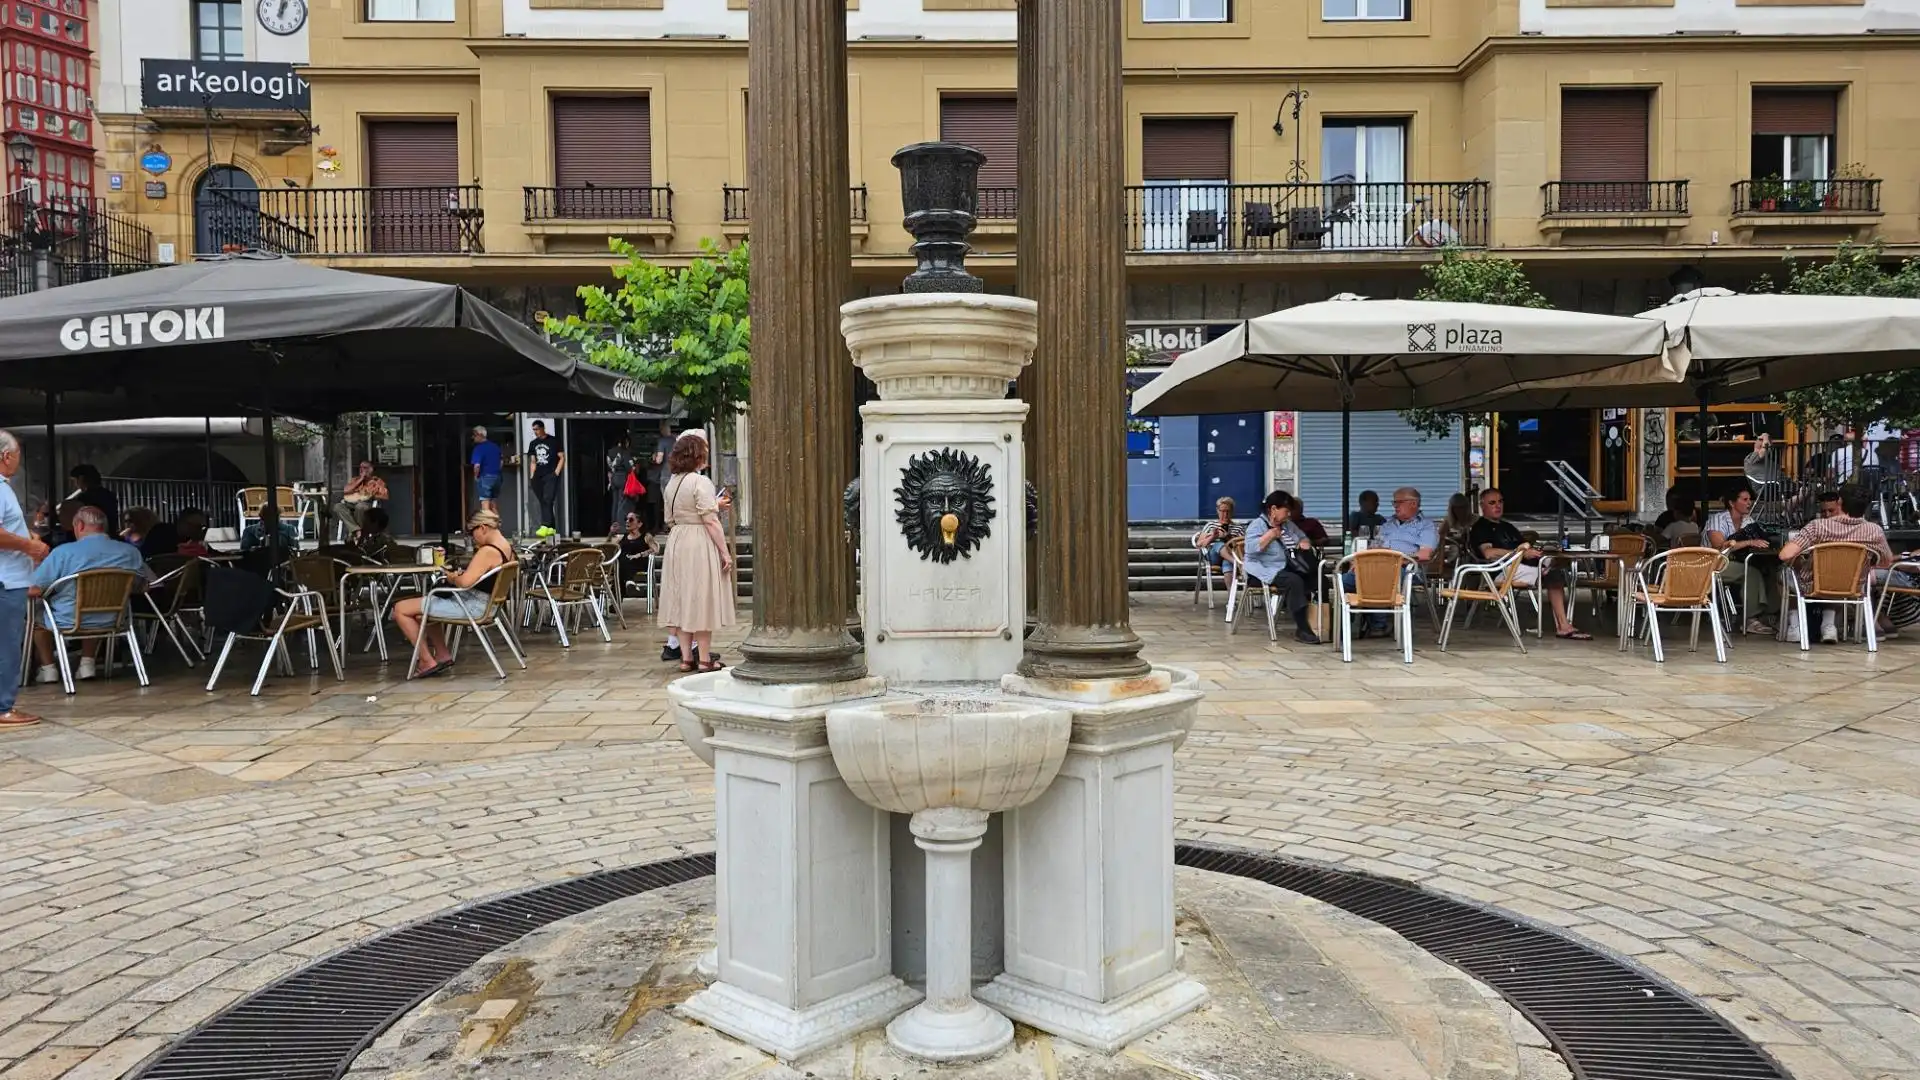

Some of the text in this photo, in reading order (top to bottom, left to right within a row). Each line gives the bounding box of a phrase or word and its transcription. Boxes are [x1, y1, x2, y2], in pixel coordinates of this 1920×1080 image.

[60, 306, 225, 351] GELTOKI
[1446, 322, 1503, 349] plaza
[1458, 344, 1503, 353] UNAMUNO
